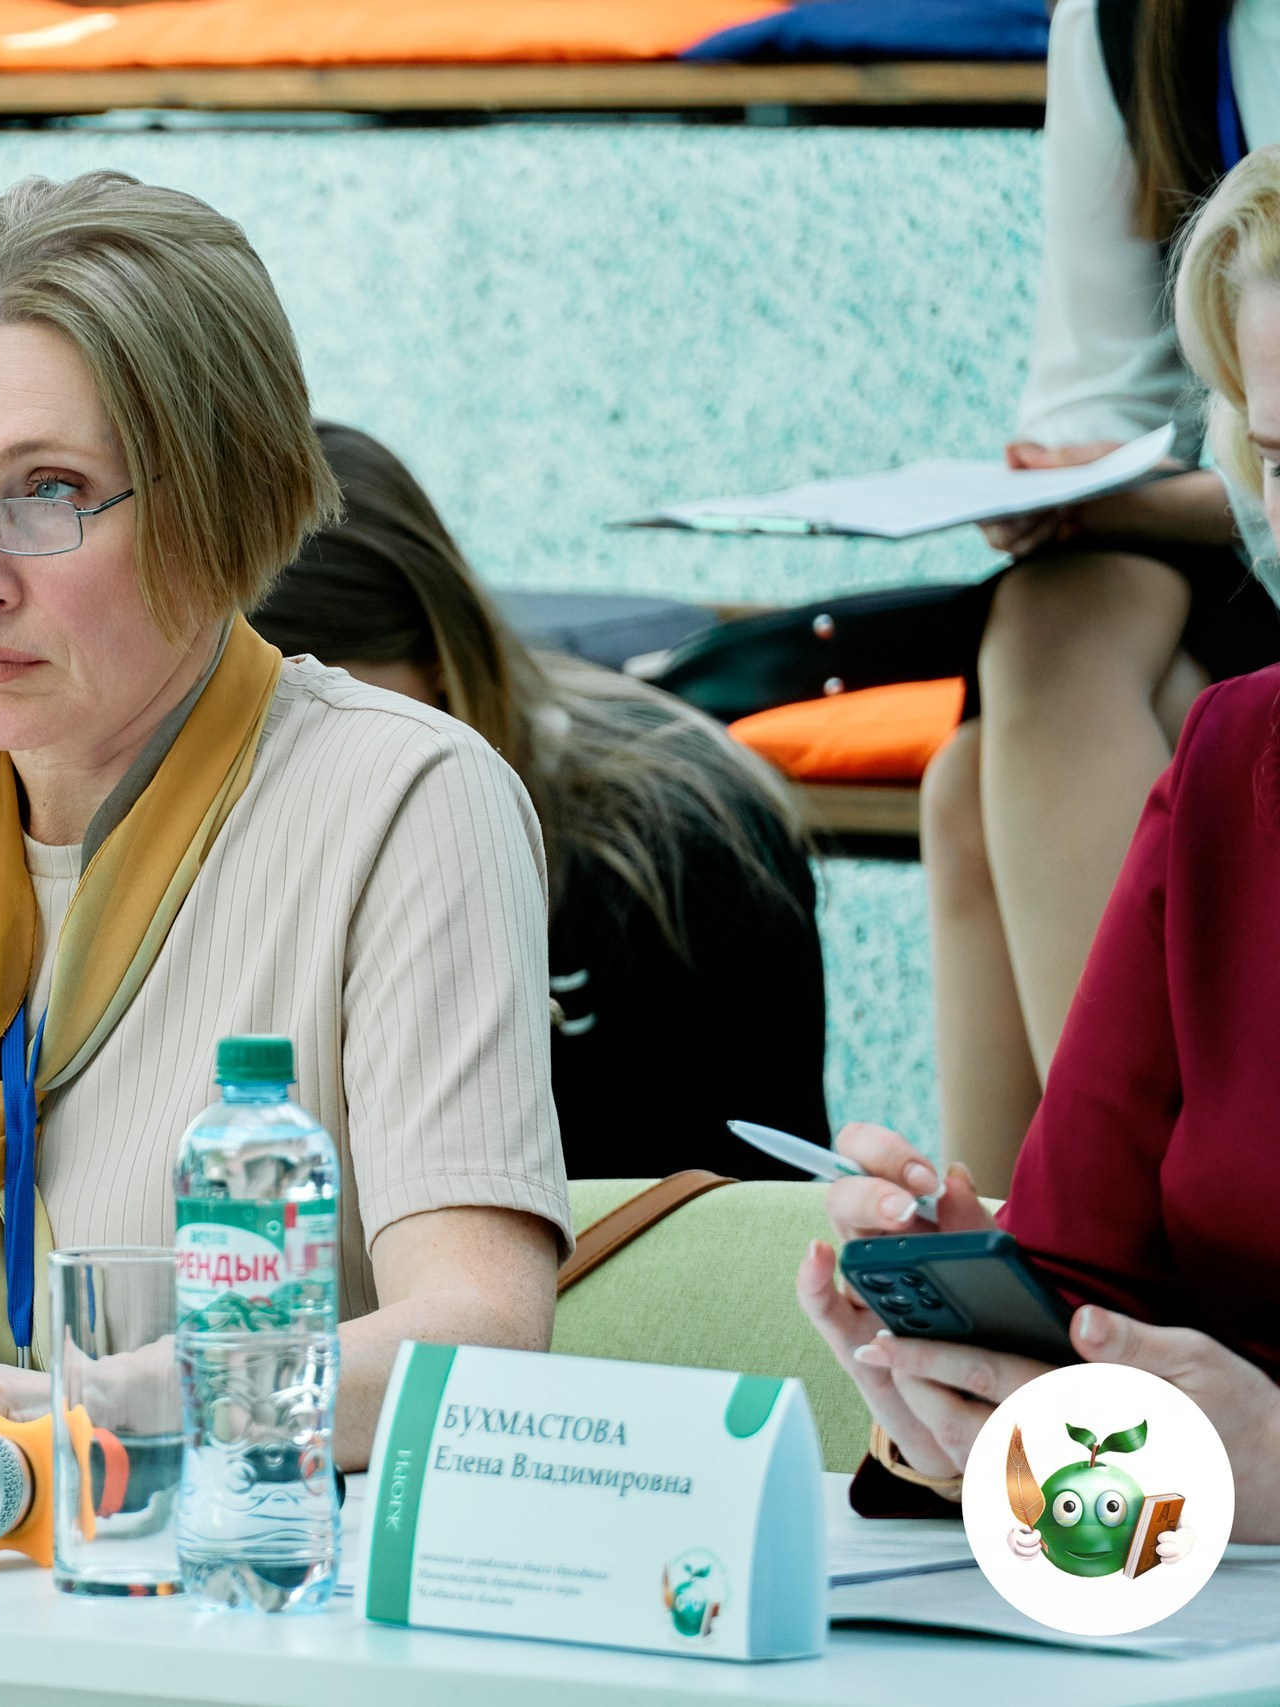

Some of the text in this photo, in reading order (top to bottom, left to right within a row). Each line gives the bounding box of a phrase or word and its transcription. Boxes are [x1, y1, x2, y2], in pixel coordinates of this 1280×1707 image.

[176, 1251, 280, 1289] РЕНДЫК
[442, 1404, 627, 1446] БУХМАСТОВА
[386, 1449, 411, 1531] ЖЮРИ
[433, 1444, 693, 1497] Елена Владимировна
